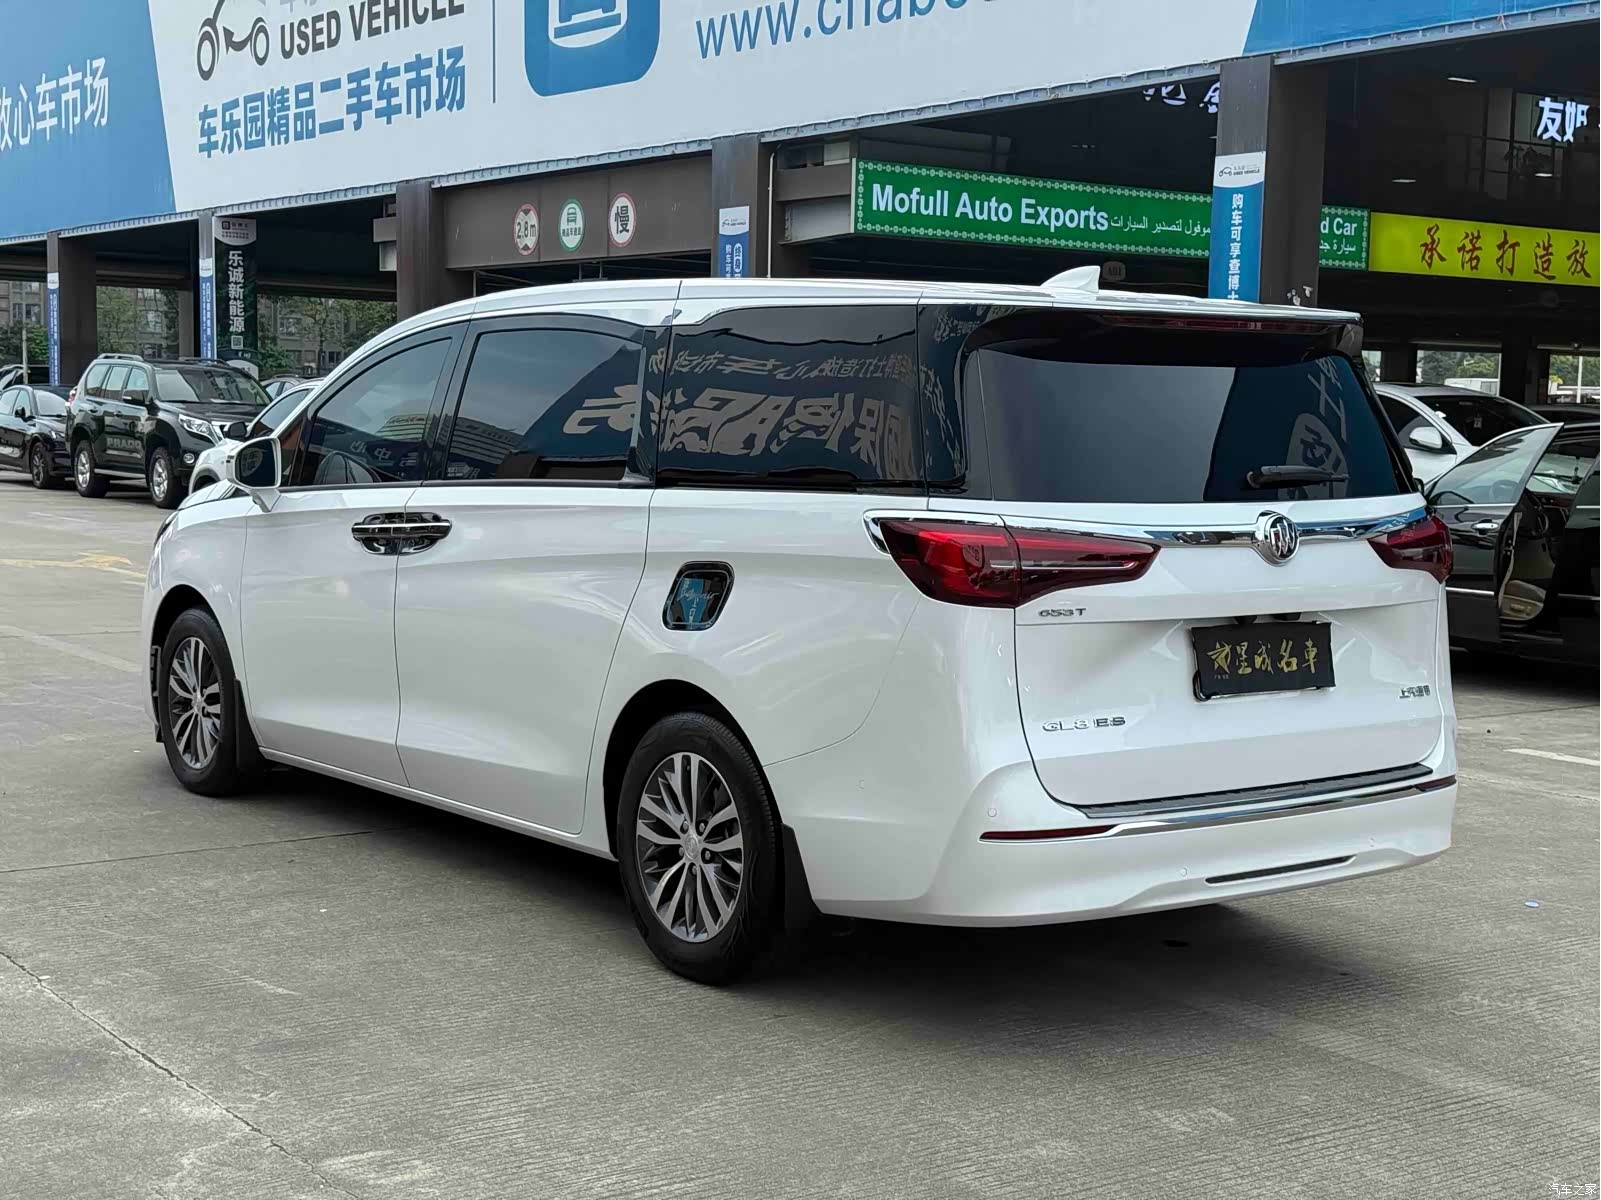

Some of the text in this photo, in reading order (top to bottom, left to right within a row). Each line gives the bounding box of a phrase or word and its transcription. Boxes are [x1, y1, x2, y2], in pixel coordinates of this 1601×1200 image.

[280, 9, 341, 60] USED
[198, 45, 466, 159] 车乐园精品二手车市场
[614, 204, 630, 235] 慢
[872, 183, 1109, 232] Mofull Auto Exports
[1333, 217, 1357, 236] Car
[516, 221, 537, 240] 2.8m
[1419, 223, 1592, 280] 承诺打造放
[228, 250, 245, 333] 乐诚新能源
[1038, 608, 1086, 617] 653T
[1042, 716, 1126, 732] GL8 ES
